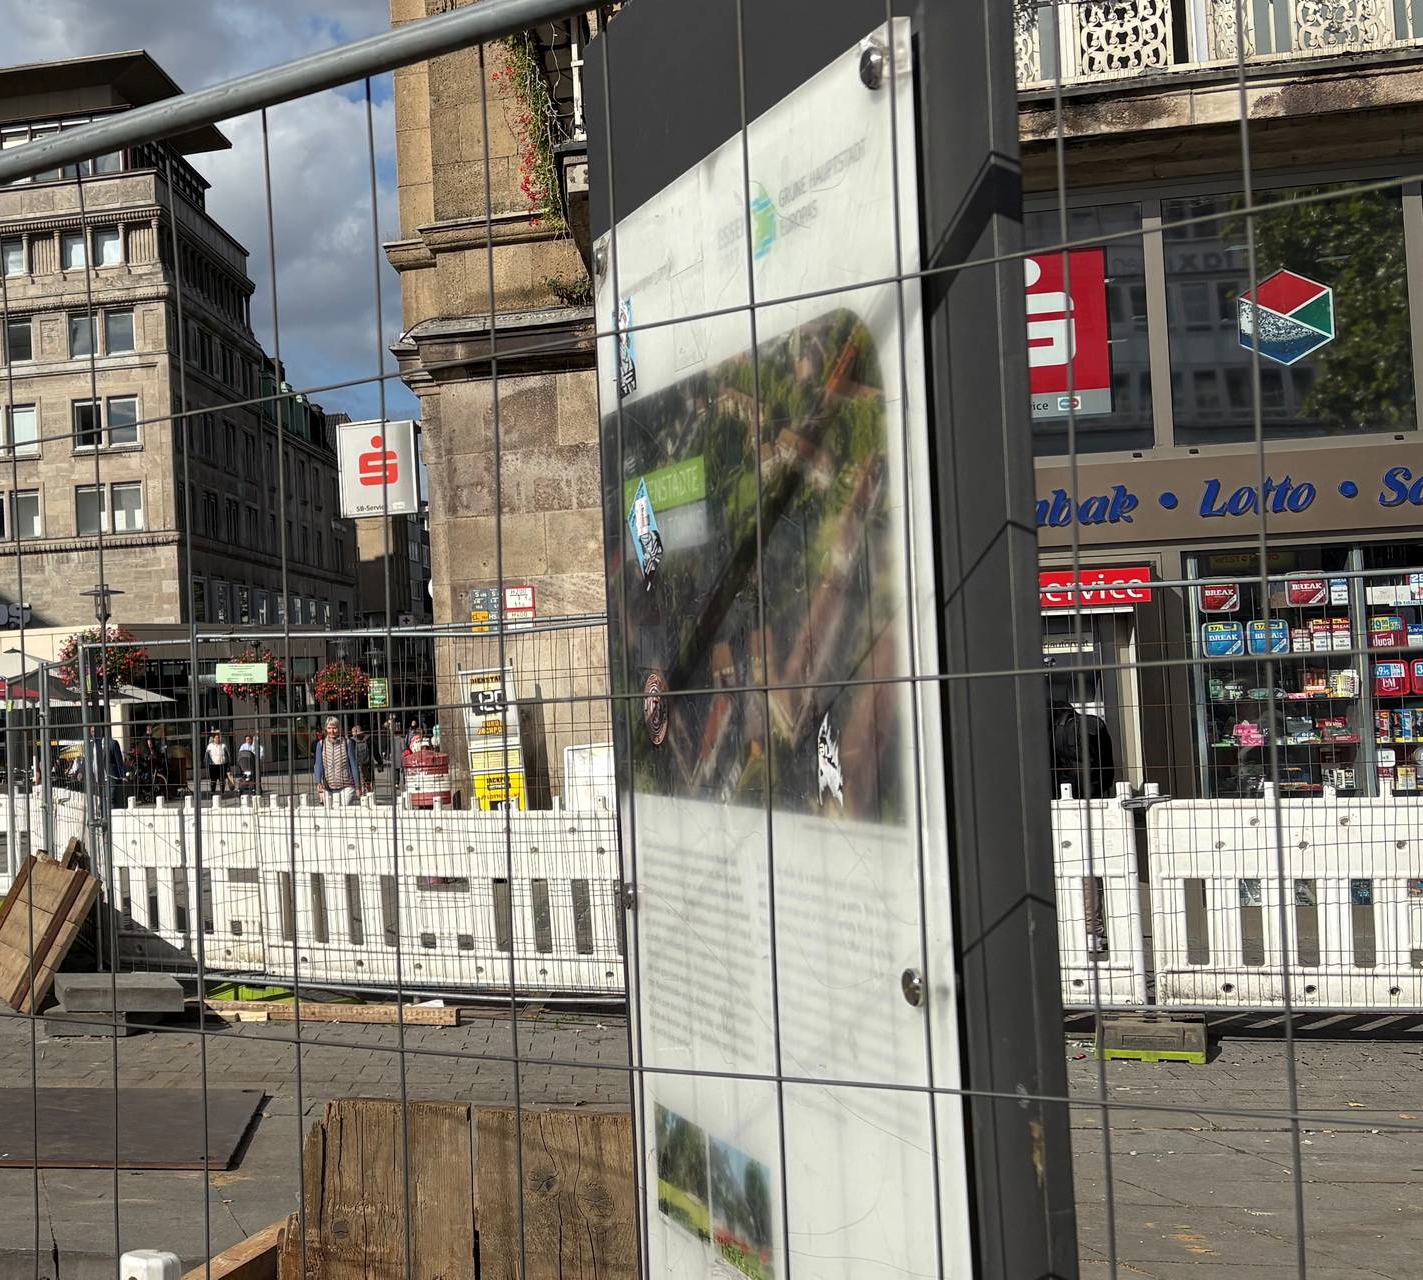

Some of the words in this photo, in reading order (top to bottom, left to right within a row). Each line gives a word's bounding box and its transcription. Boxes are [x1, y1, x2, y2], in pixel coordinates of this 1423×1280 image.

[1199, 475, 1317, 519] Lotto
[1039, 573, 1144, 602] ervice
[1291, 582, 1323, 590] BREAK
